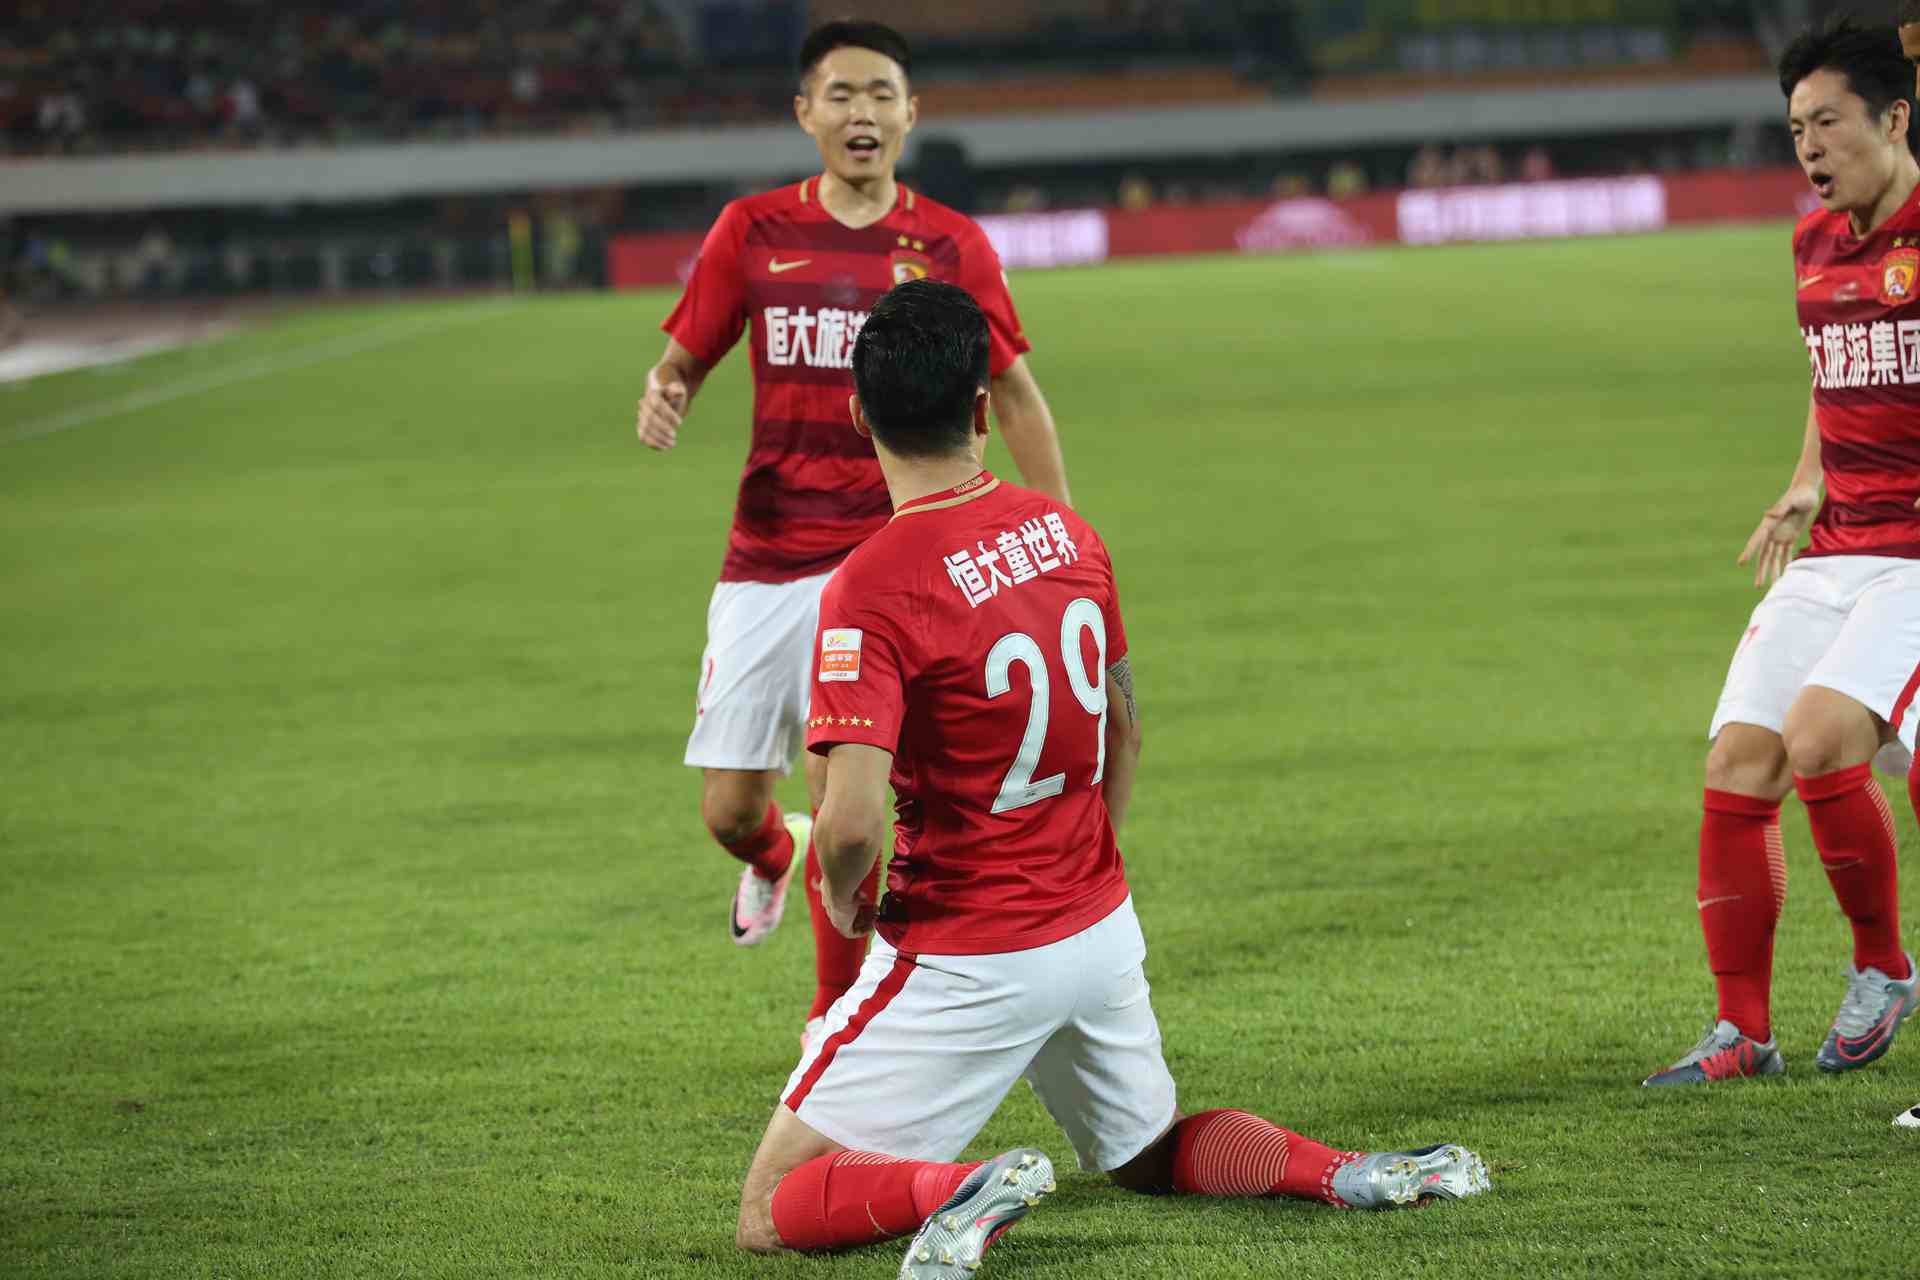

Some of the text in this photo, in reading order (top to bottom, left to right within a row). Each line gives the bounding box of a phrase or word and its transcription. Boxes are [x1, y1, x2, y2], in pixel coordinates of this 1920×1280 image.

[943, 512, 1079, 609] 恒大童世界
[985, 598, 1107, 814] 29
